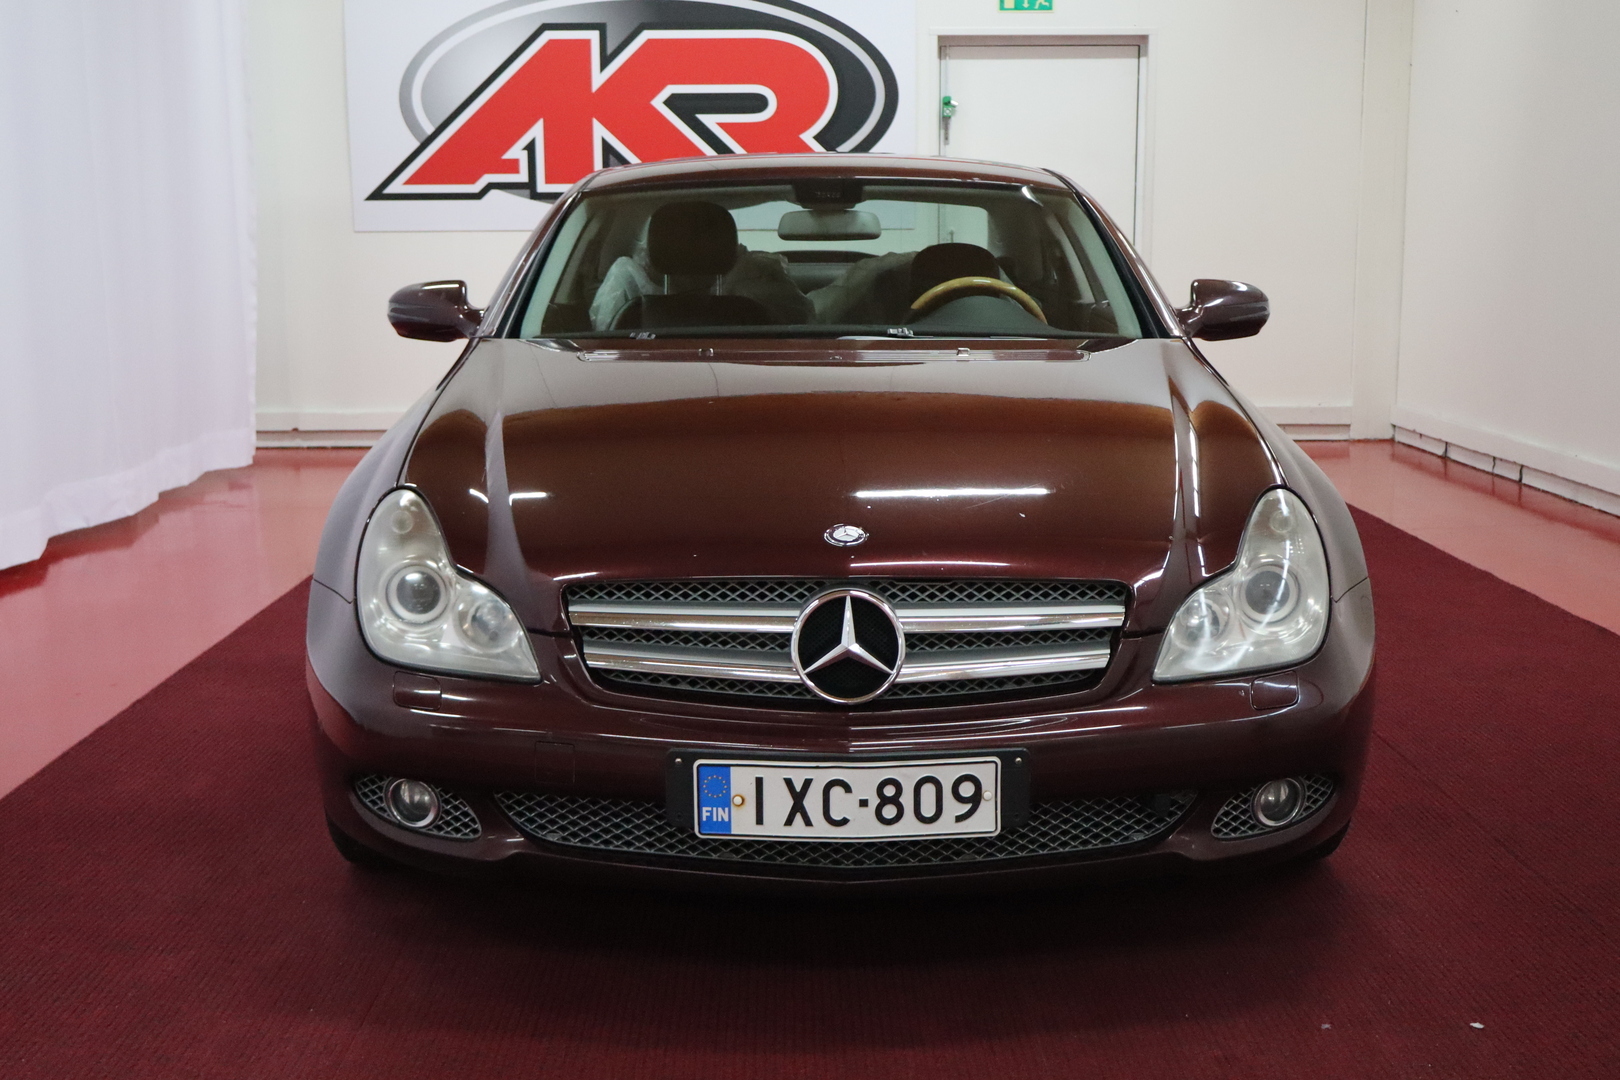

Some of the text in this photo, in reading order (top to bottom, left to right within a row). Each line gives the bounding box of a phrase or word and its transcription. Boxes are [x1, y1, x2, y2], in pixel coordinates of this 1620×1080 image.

[378, 29, 838, 195] AKR
[702, 807, 729, 822] FIN
[755, 773, 983, 827] IXC-809
